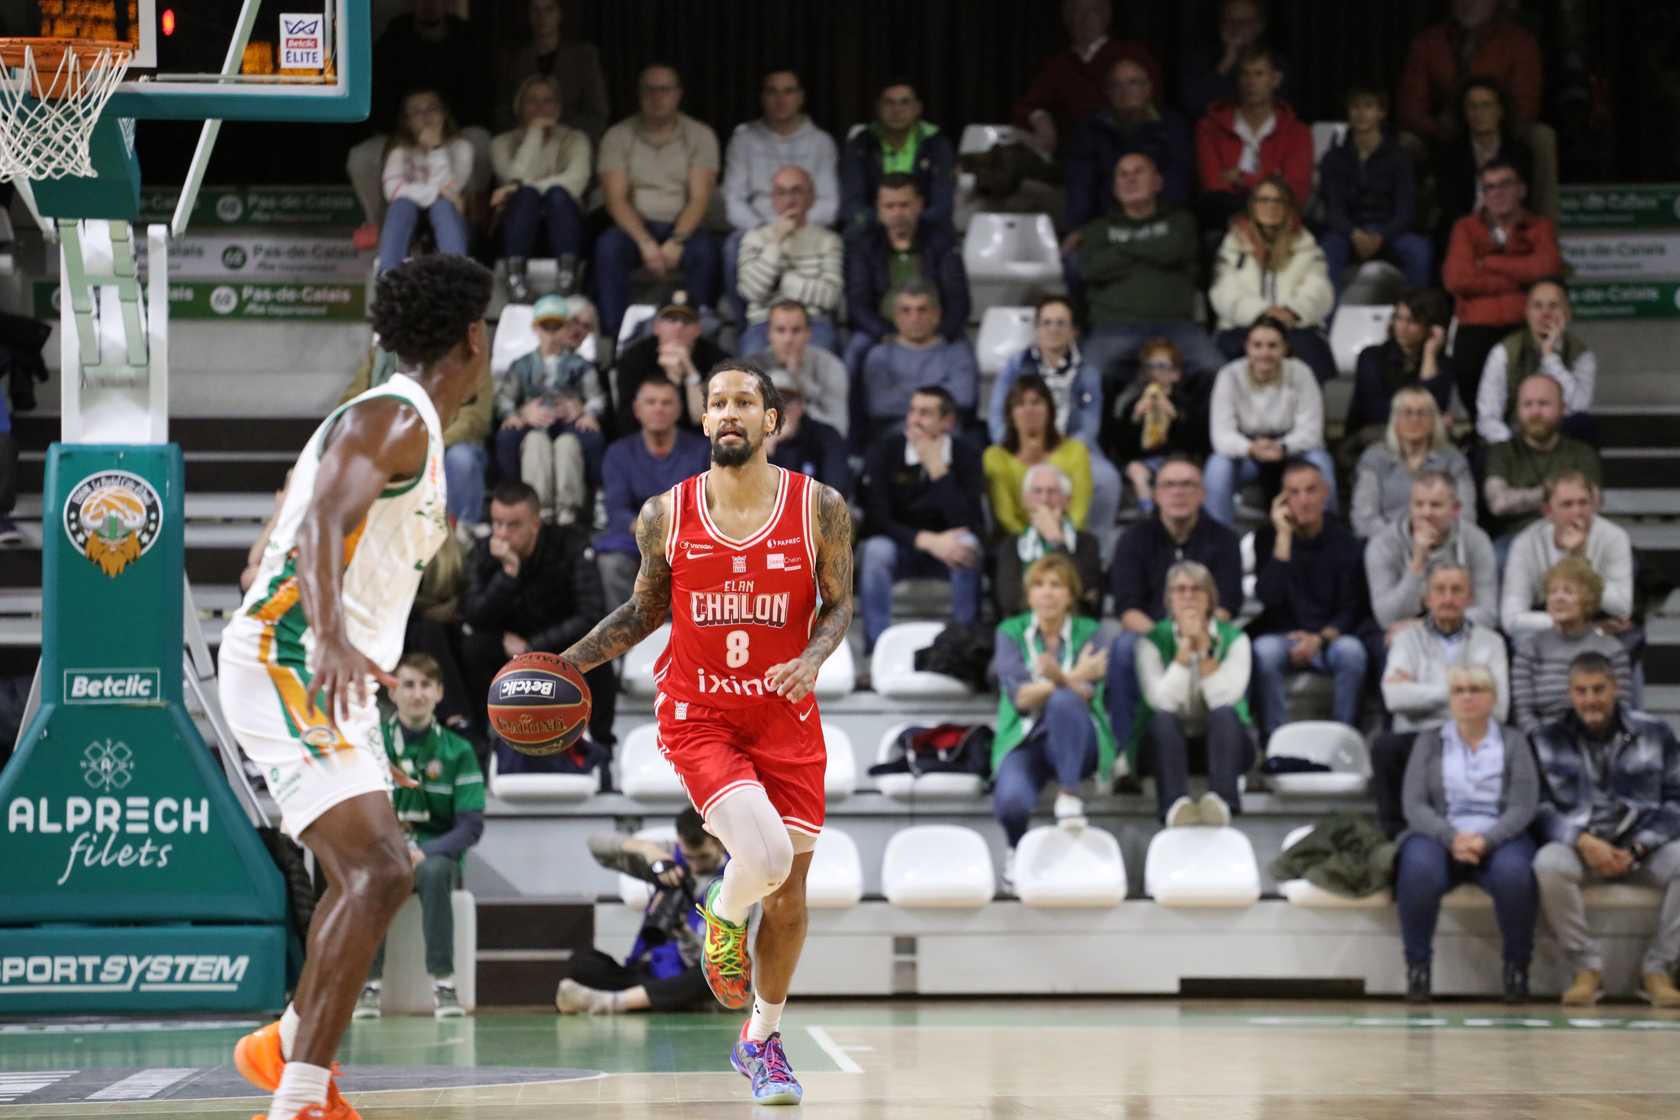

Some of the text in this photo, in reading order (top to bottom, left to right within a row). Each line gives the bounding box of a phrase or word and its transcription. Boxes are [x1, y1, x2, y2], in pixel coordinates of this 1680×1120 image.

[242, 286, 351, 302] Pas-de-Calais
[724, 580, 754, 593] ELAN
[690, 591, 790, 628] CHALON
[726, 629, 750, 669] 8
[71, 674, 152, 698] Betclic
[501, 680, 554, 697] Betclic
[8, 796, 210, 834] ALPRECH
[57, 831, 173, 886] filets
[0, 955, 250, 986] PORTSYSTEM
